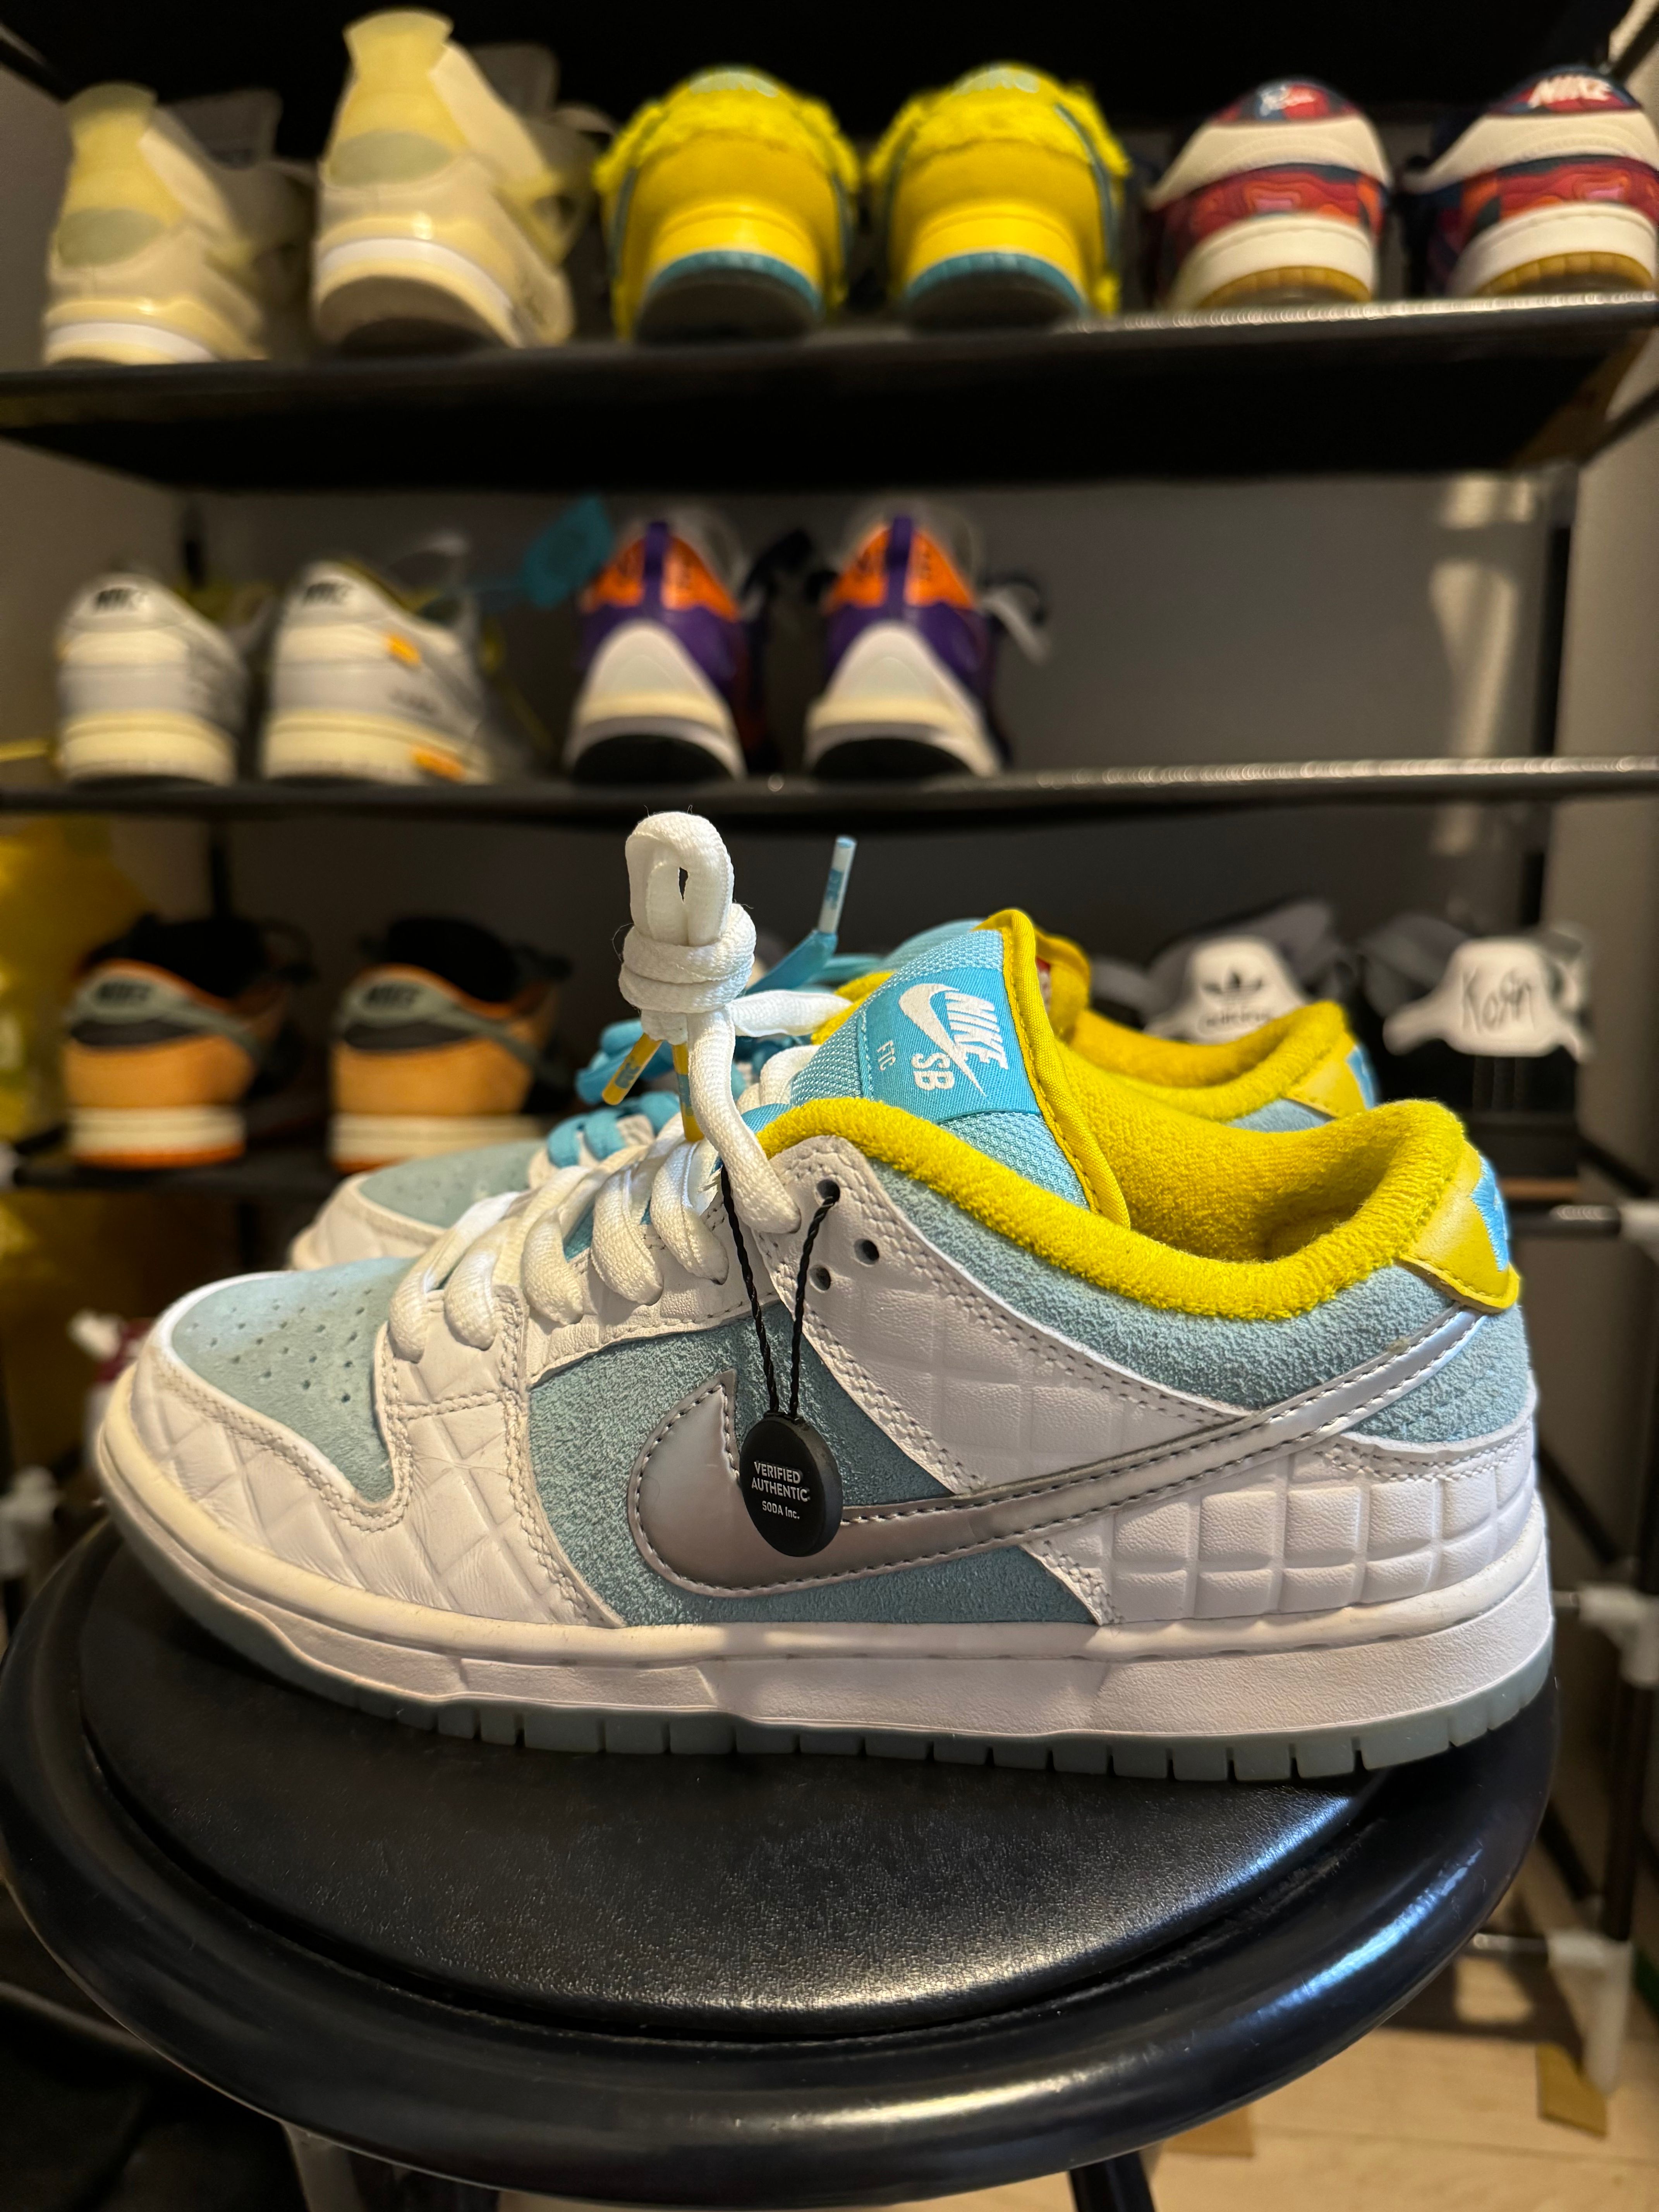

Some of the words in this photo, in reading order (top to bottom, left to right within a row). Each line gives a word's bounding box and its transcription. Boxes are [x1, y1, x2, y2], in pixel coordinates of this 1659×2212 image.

[945, 992, 1009, 1070] NIKE
[876, 1040, 896, 1071] FTC
[911, 1052, 955, 1091] SB
[753, 1461, 801, 1484] VERIFIED
[751, 1477, 809, 1502] AUTHENTIC
[762, 1500, 783, 1516] SODA
[785, 1506, 800, 1520] Inc.
